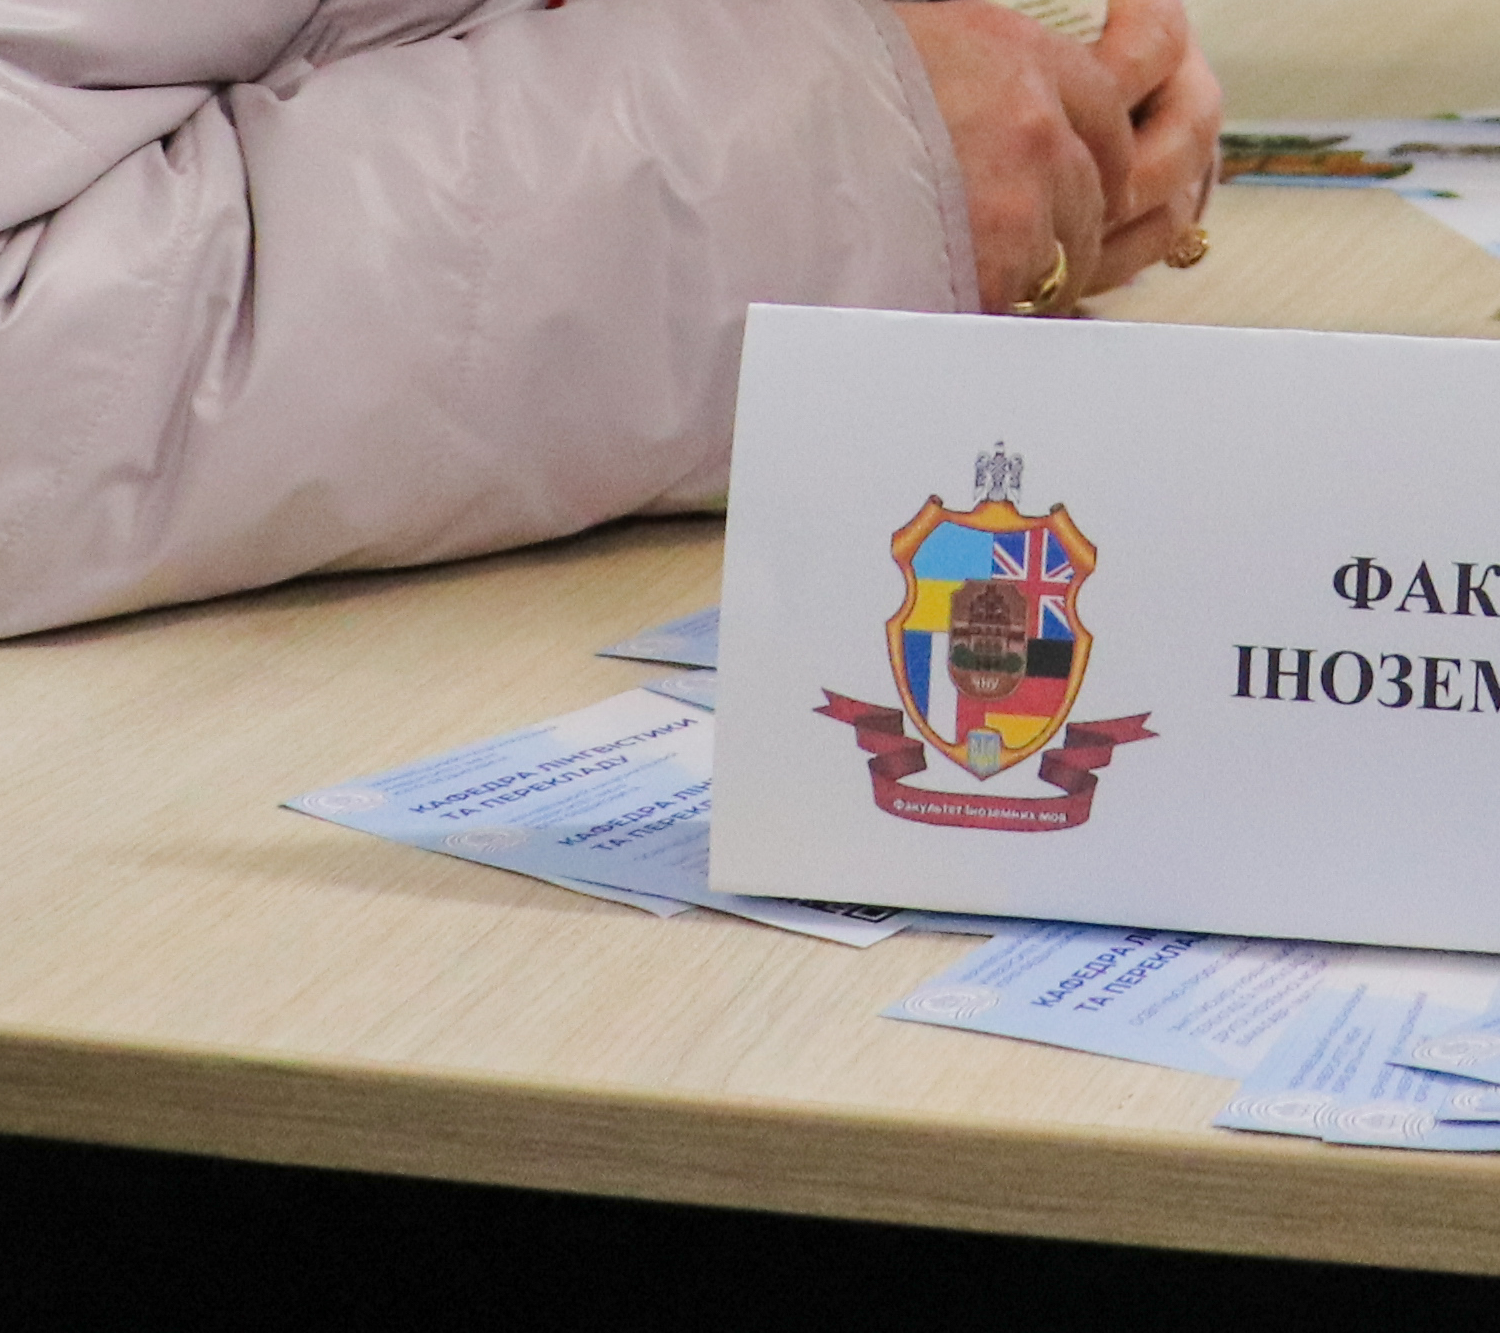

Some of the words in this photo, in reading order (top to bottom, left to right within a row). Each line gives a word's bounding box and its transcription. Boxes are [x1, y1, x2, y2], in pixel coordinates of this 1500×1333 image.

[409, 770, 538, 814] КАФЕДРА
[440, 806, 481, 821] ТА
[480, 754, 630, 809] ПЕРЕКЛАДУ
[893, 798, 963, 815] Факультет
[557, 800, 677, 846] КАФЕДРА
[590, 837, 633, 851] ТА
[628, 799, 712, 838] ПЕРЕКЛ
[1030, 946, 1137, 1009] КАФЕДРА
[1073, 995, 1115, 1013] ТА
[1103, 935, 1203, 994] ПЕРЕКЛА
